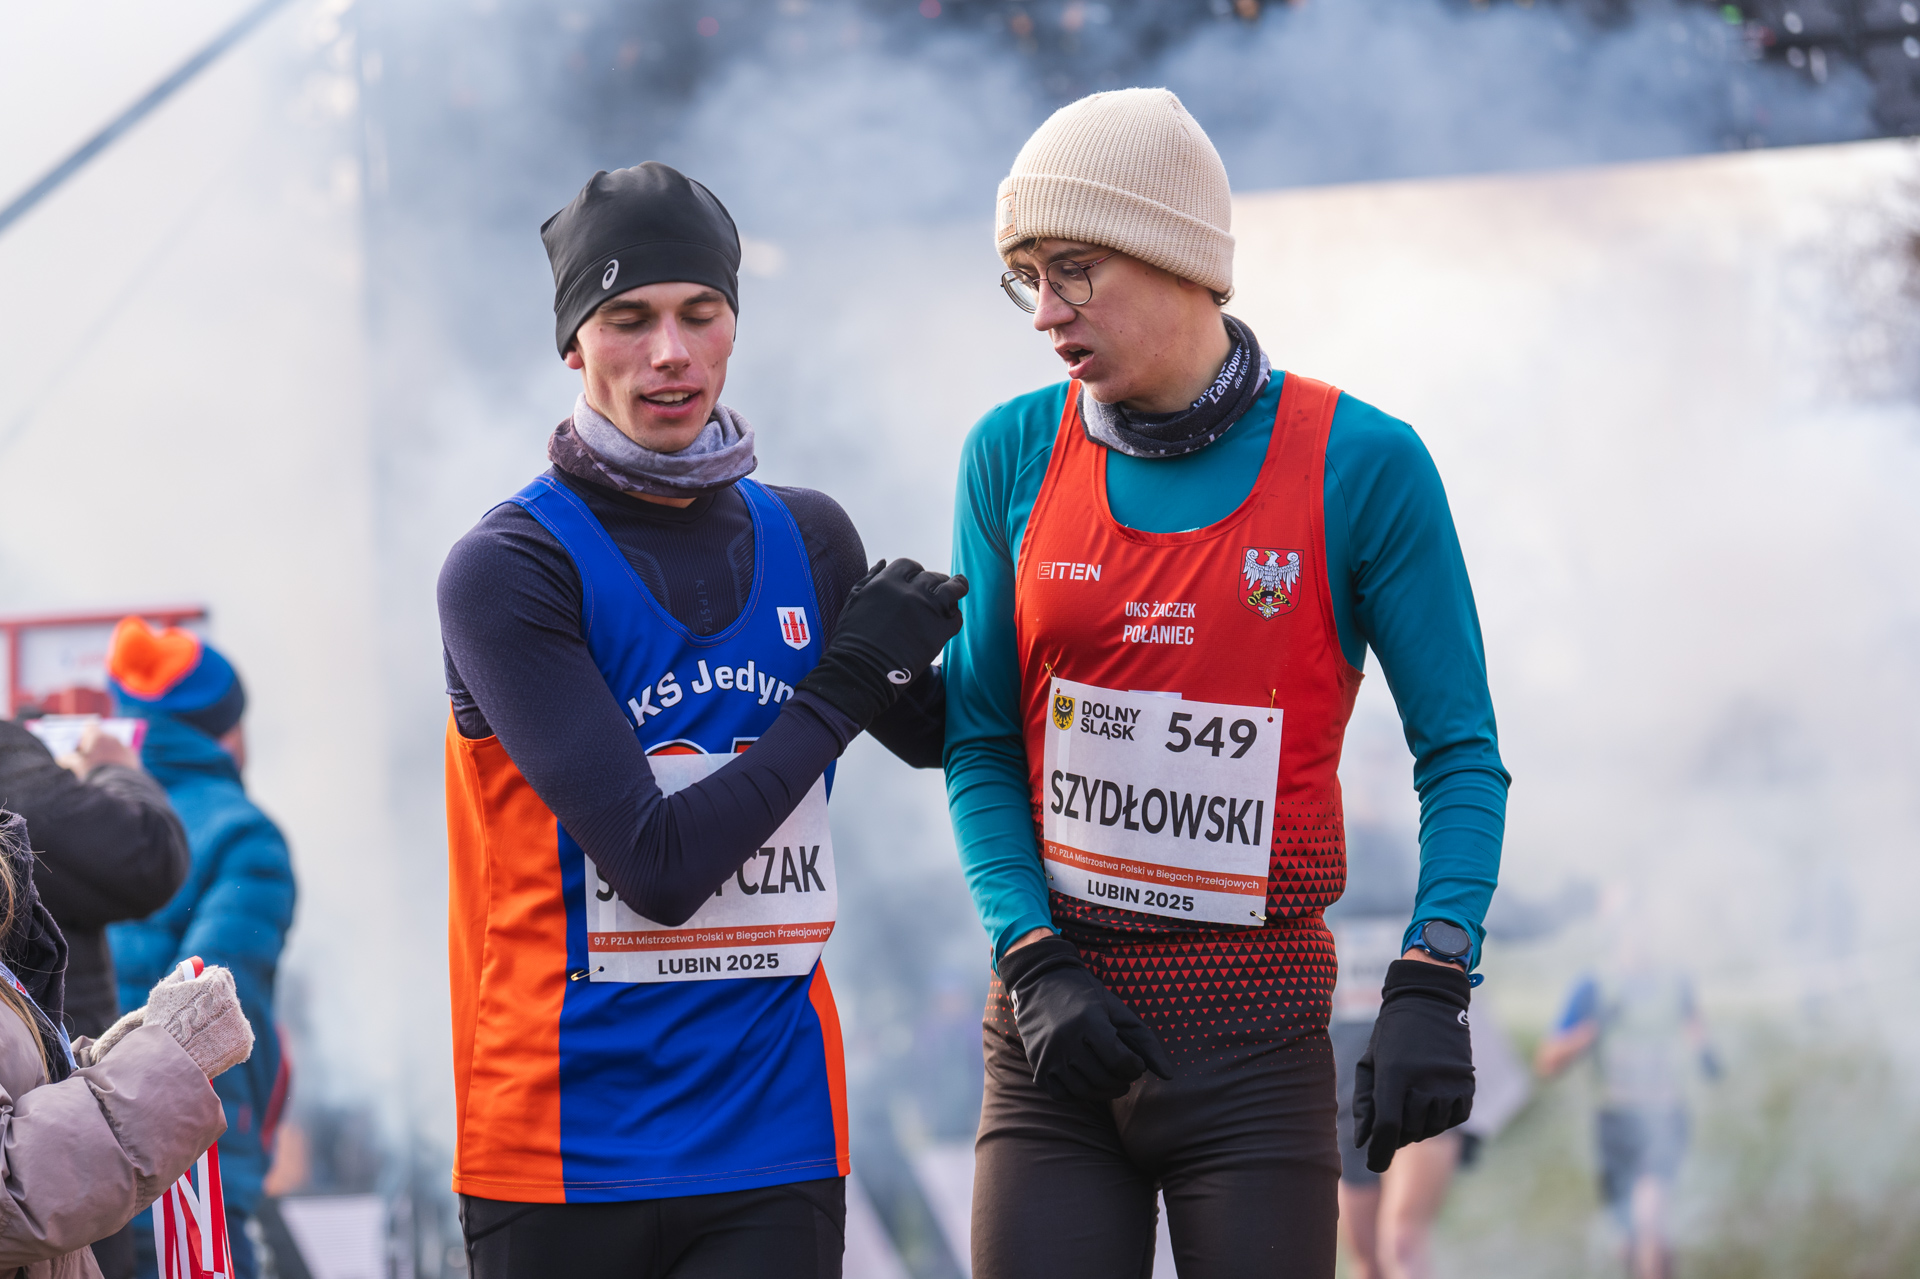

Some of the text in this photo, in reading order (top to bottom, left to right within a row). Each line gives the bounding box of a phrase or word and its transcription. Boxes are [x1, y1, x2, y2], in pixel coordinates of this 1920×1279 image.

[695, 579, 713, 634] KIPSTA
[1125, 600, 1196, 618] UKS ŻACZEK
[1122, 624, 1195, 645] POŁANIEC
[626, 659, 796, 731] KS Jedyn
[1081, 700, 1142, 724] DOLNY
[1080, 714, 1135, 741] ŚLĄSK
[1164, 711, 1258, 759] 549
[1050, 769, 1265, 847] SZYDŁOWSKI
[1048, 845, 1260, 891] 97. PZLA Mistrzostwa Polski w Biegach Przełajowych
[1087, 879, 1195, 912] LUBIN 2025
[593, 926, 831, 946] 97. PZLA Mistrzostwa Polski w Biegach Przełajowych
[658, 952, 780, 975] LUBIN 2025
